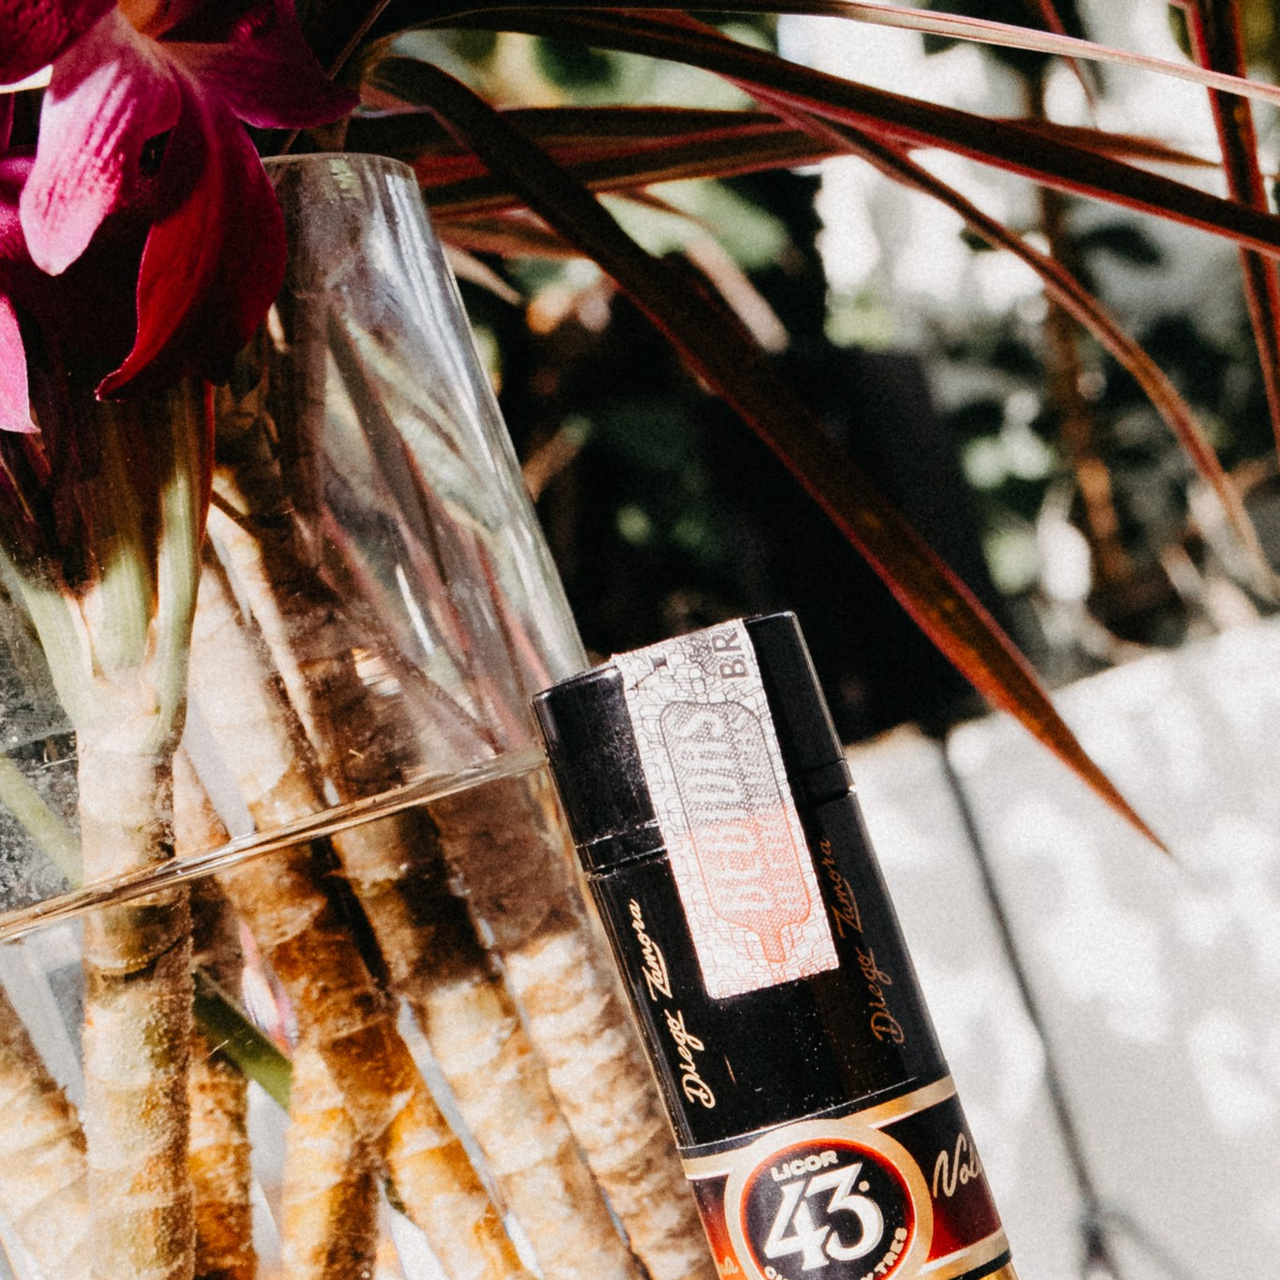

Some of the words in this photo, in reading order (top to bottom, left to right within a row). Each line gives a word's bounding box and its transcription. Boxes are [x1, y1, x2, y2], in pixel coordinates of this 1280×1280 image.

[819, 837, 864, 938] Zamora
[629, 898, 674, 1001] Zamora
[855, 947, 904, 1044] Diego
[663, 1009, 717, 1109] Diego
[770, 1150, 839, 1182] LICOR
[763, 1161, 885, 1272] 43
[873, 1227, 909, 1276] TRES
